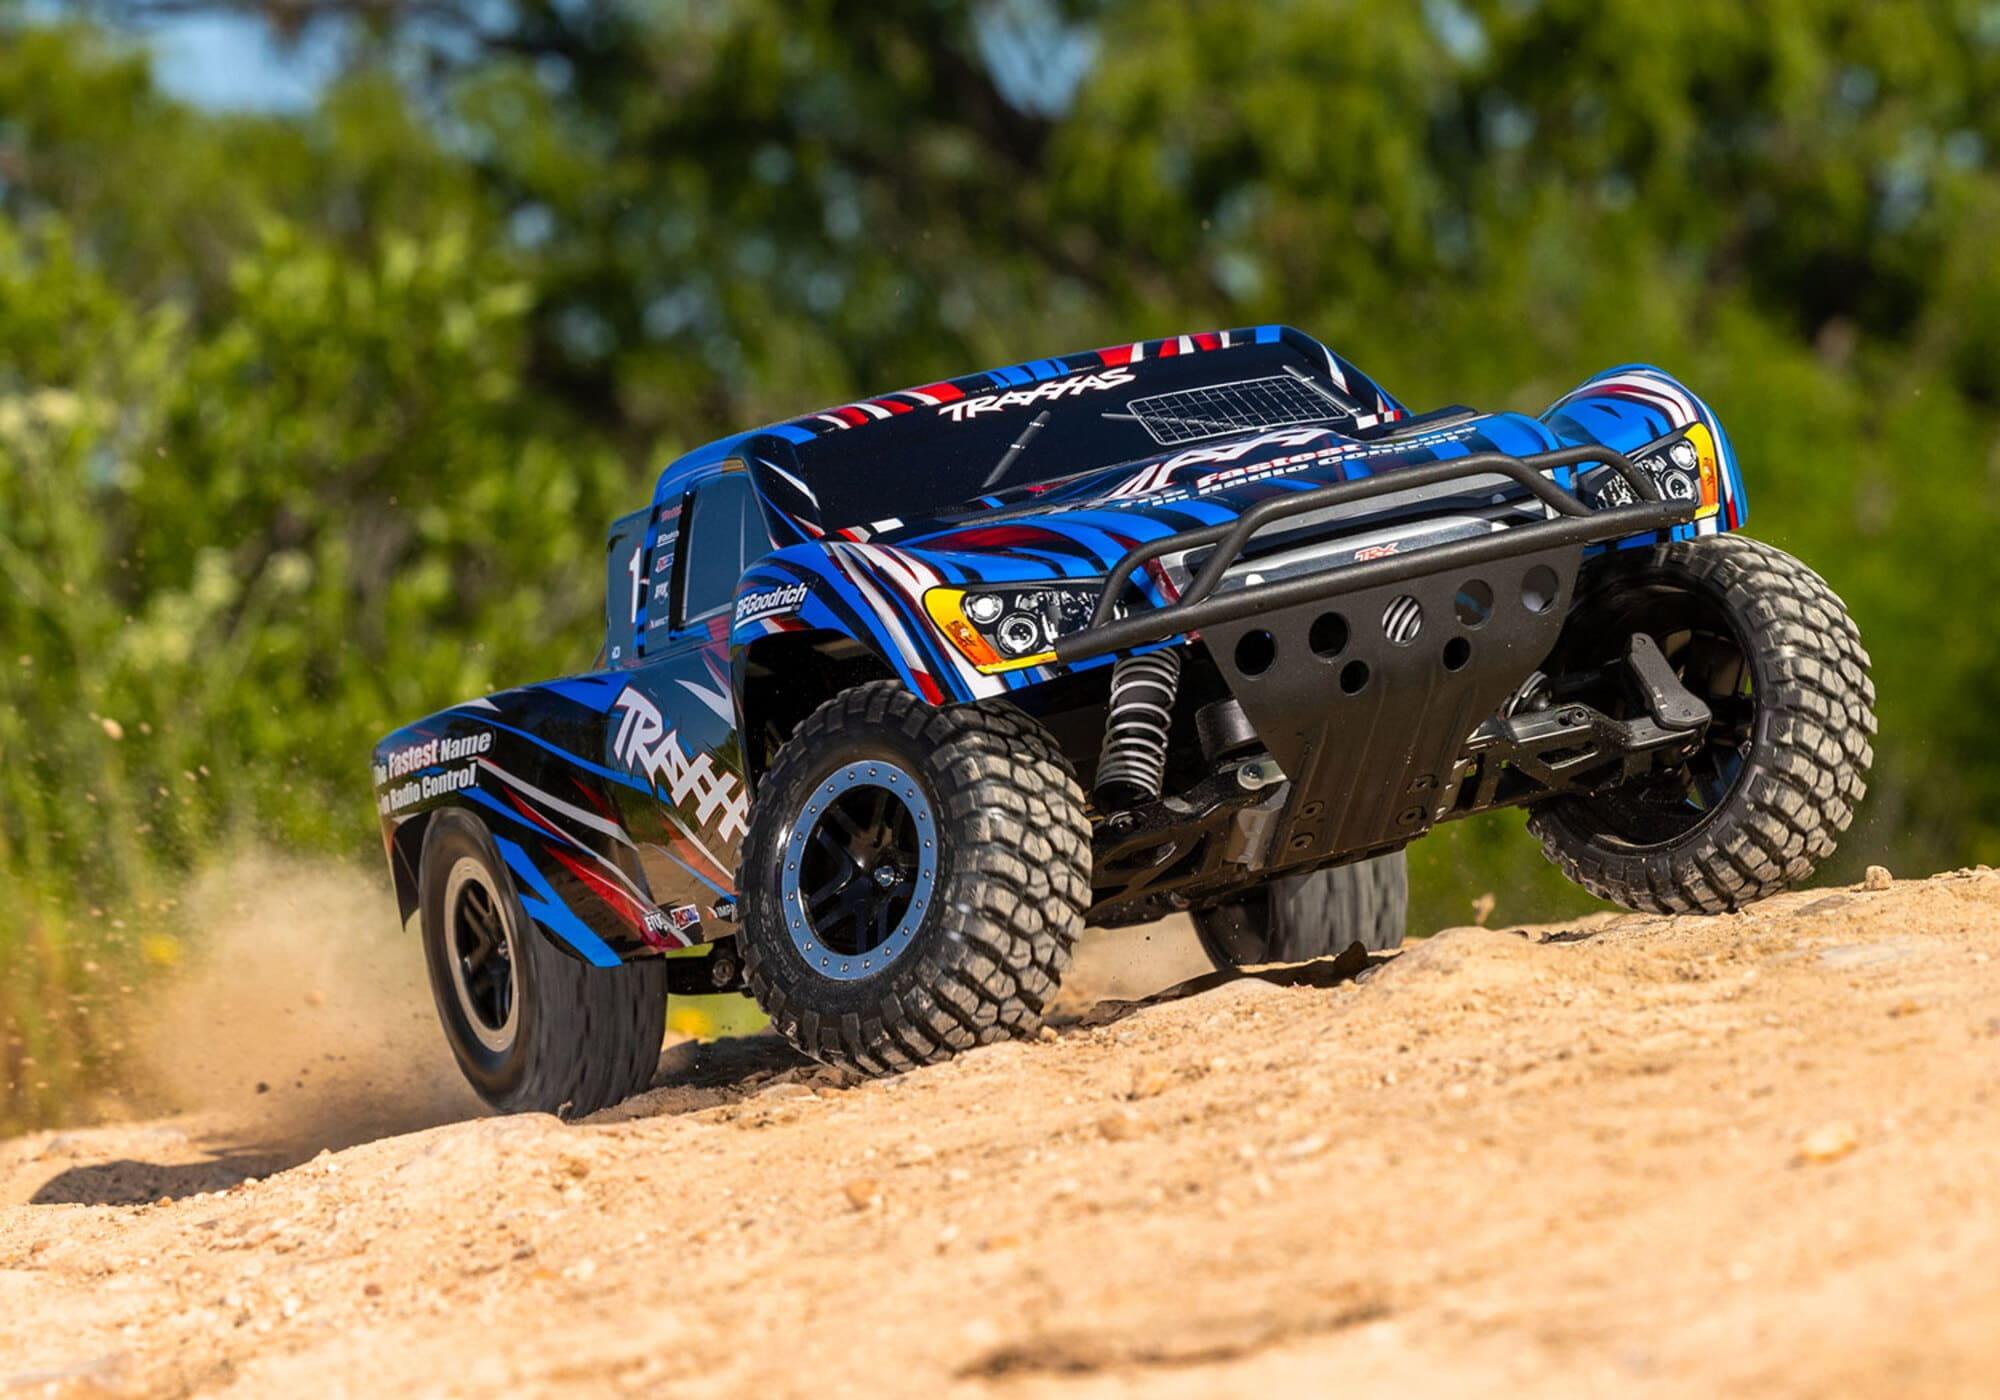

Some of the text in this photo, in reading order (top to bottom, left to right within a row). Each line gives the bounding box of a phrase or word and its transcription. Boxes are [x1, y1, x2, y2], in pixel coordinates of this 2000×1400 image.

[938, 366, 1136, 422] TRAXXAS
[735, 581, 809, 622] BFGoodrich
[387, 738, 439, 780] Fastest
[440, 731, 493, 763] Name
[390, 781, 421, 812] Radio
